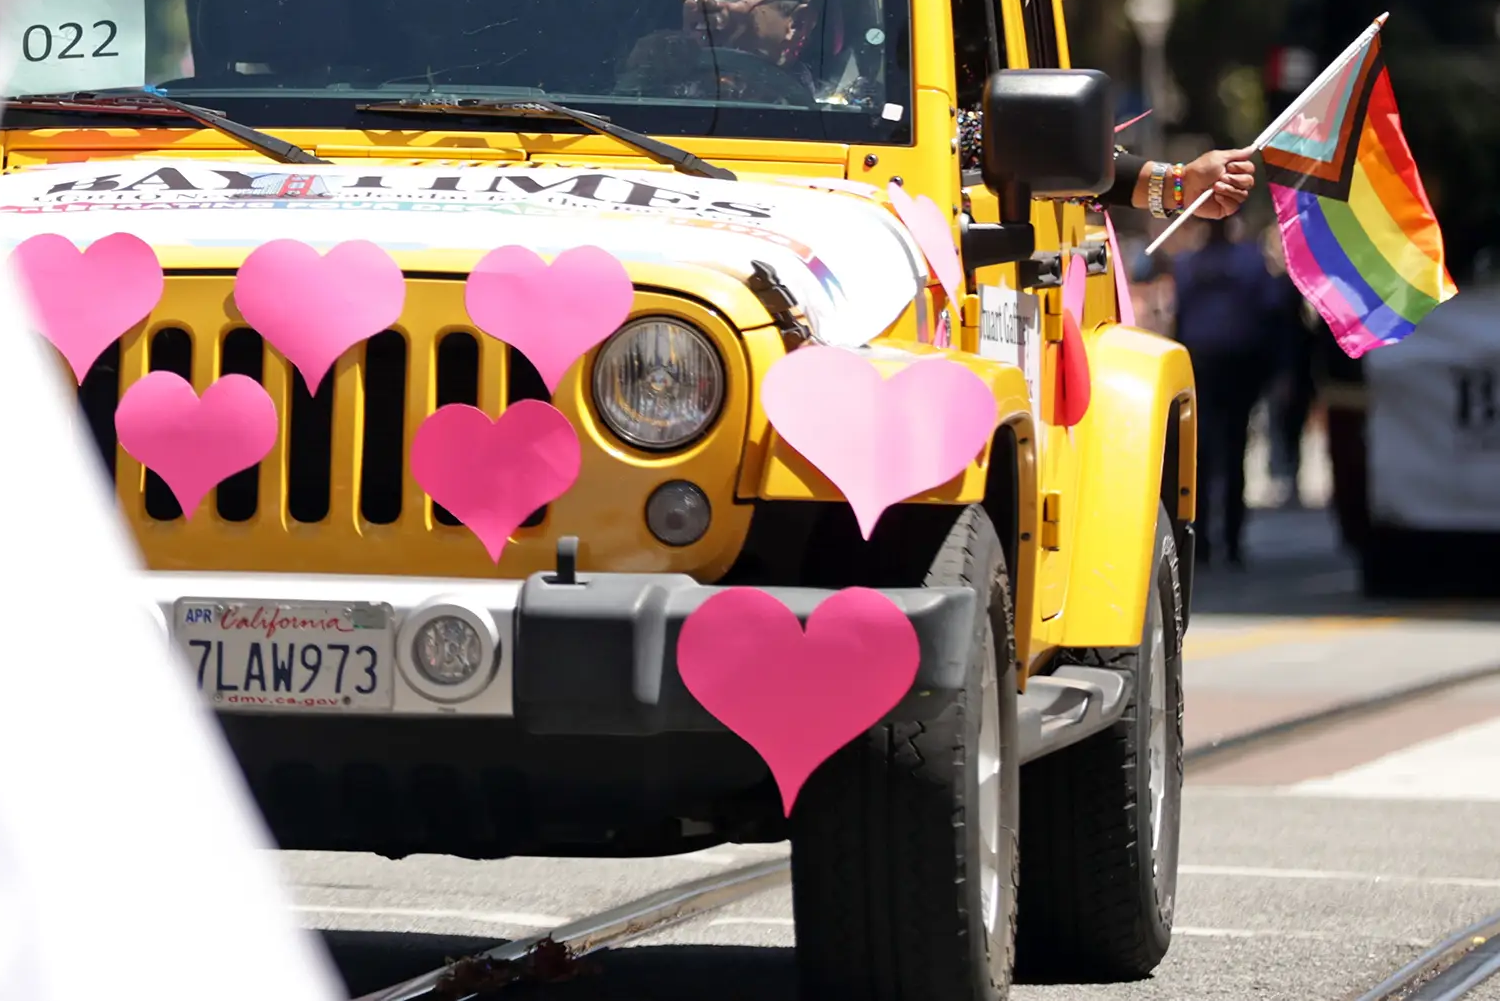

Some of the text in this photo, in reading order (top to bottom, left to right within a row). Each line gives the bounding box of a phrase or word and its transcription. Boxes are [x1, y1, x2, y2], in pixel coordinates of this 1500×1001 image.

[22, 19, 120, 62] 022
[47, 166, 773, 219] BAY TIMES
[286, 201, 400, 212] FOUR
[186, 606, 354, 639] APR California
[189, 639, 378, 694] 7LAW973
[228, 695, 339, 706] dmv.ca.gov
